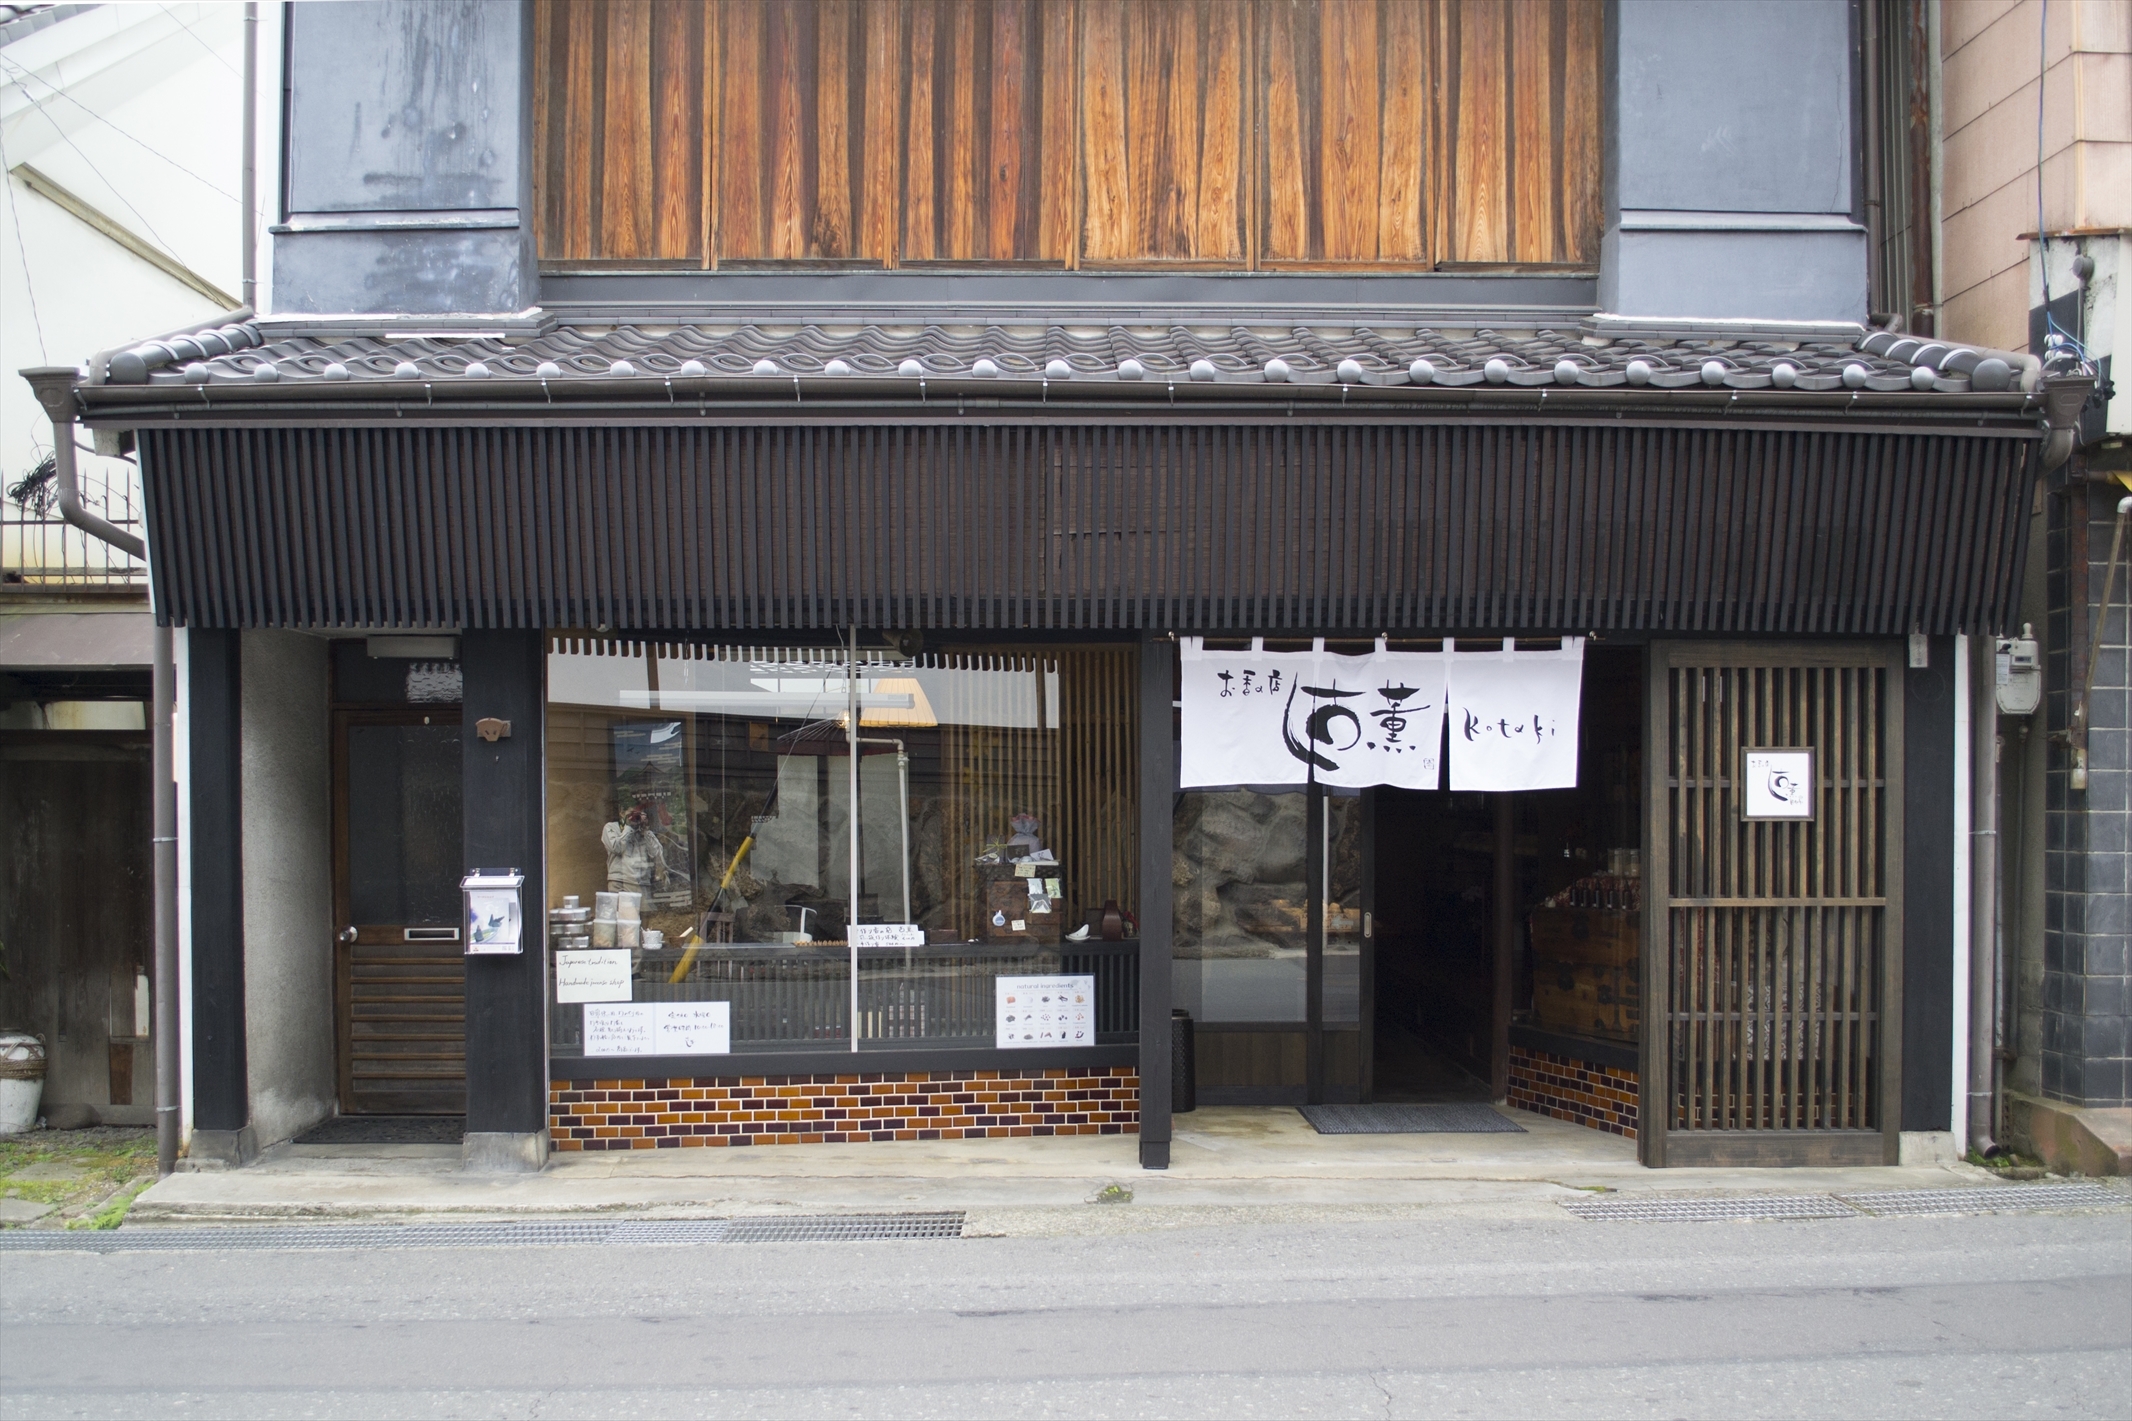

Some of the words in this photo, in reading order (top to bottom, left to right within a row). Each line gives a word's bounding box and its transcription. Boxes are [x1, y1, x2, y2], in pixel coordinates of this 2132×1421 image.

[1217, 669, 1282, 698] お香の店
[559, 954, 587, 968] Japanese
[558, 977, 589, 987] Handmade
[1040, 982, 1074, 991] ingredients
